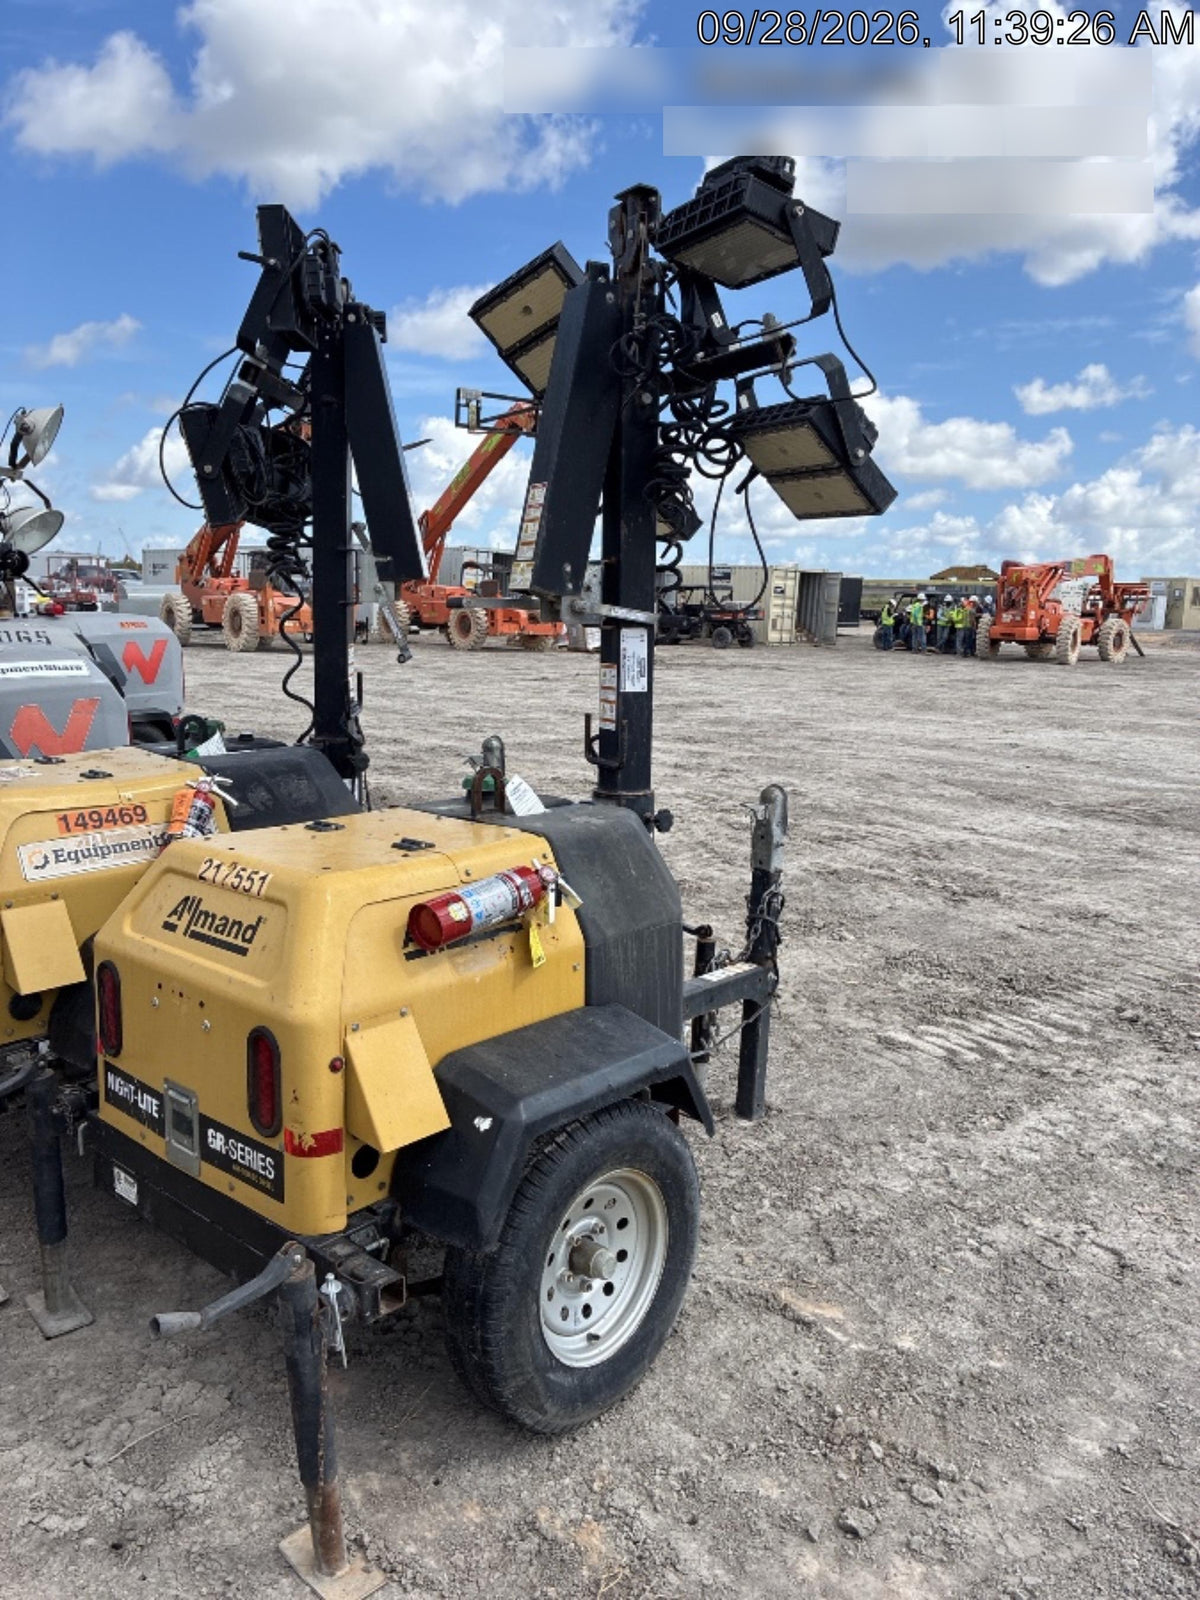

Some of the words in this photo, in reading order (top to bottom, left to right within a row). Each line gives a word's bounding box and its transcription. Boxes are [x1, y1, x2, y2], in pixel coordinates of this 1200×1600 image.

[58, 804, 148, 832] 149469
[165, 895, 264, 945] Allmand
[107, 1071, 160, 1119] NIGHT-LITE
[207, 1128, 275, 1180] GR-SERIES
